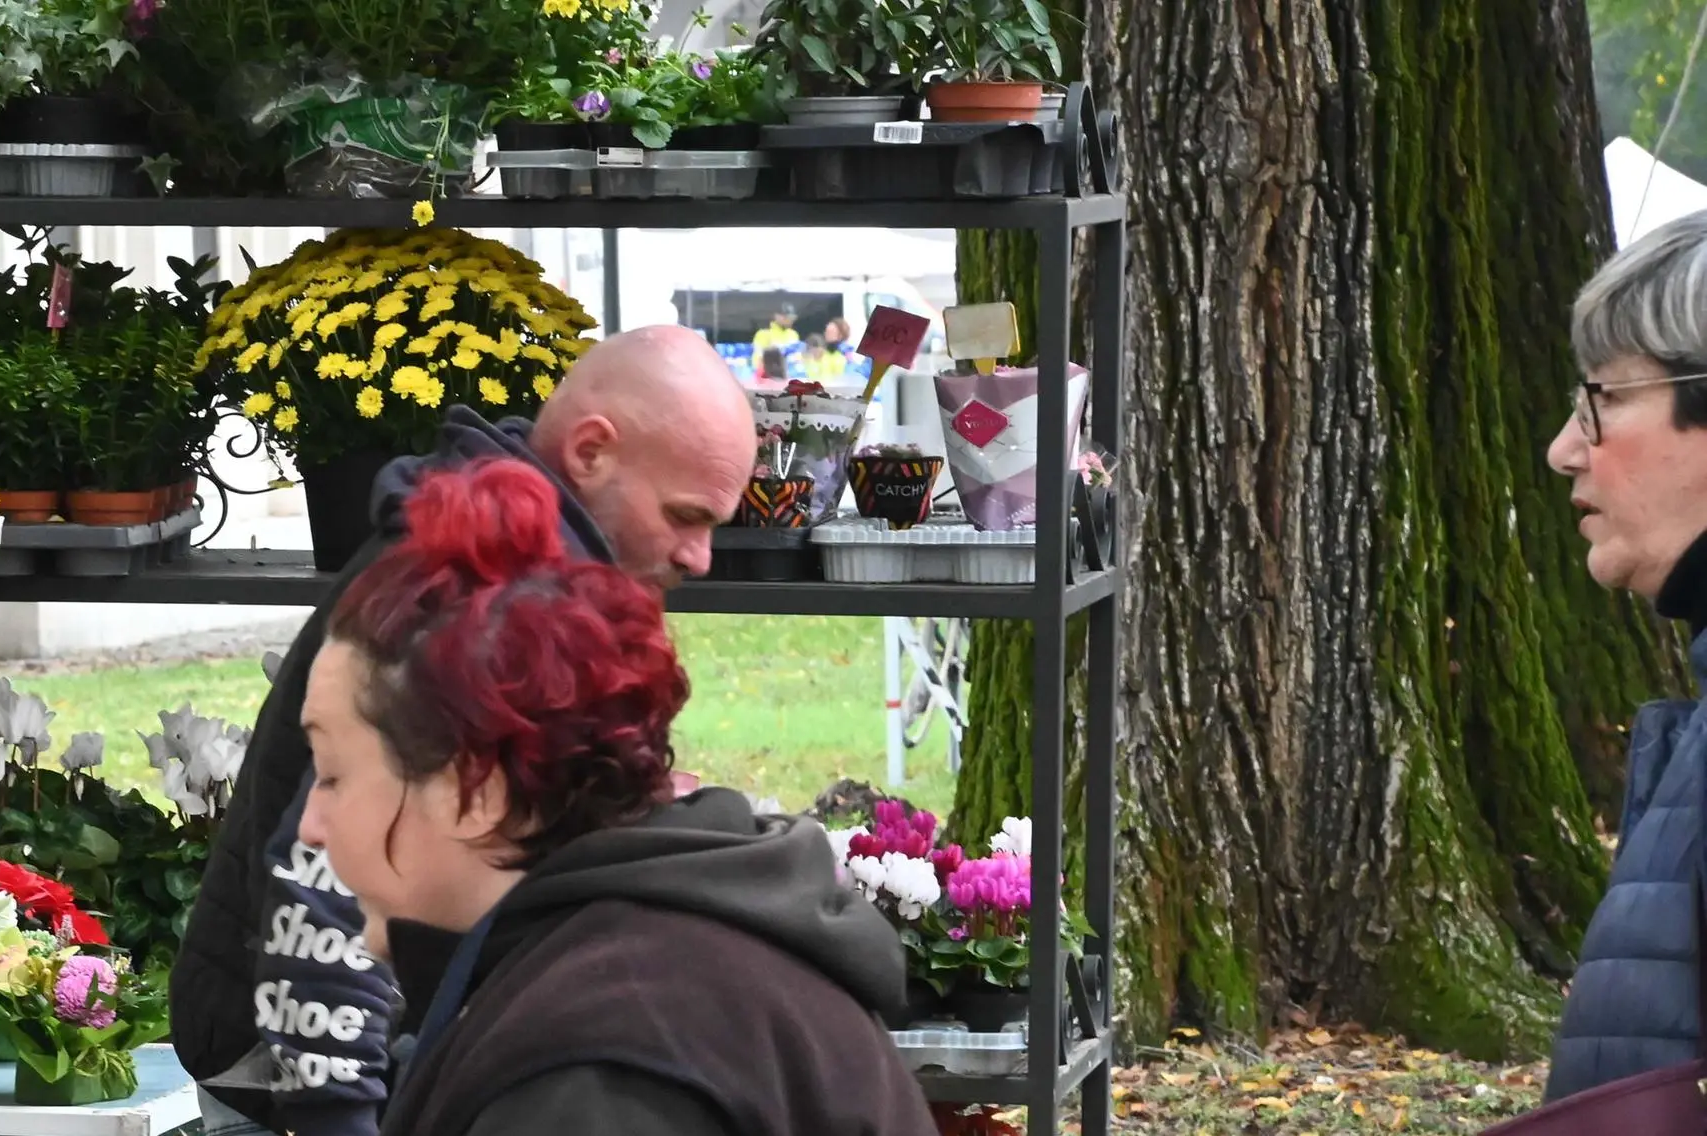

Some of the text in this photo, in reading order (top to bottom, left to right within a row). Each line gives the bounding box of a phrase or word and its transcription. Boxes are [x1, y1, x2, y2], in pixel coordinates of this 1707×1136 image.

[875, 483, 927, 497] CATCHY
[272, 841, 355, 897] Sho
[264, 903, 375, 971] Shoe
[254, 980, 365, 1041] Shoe
